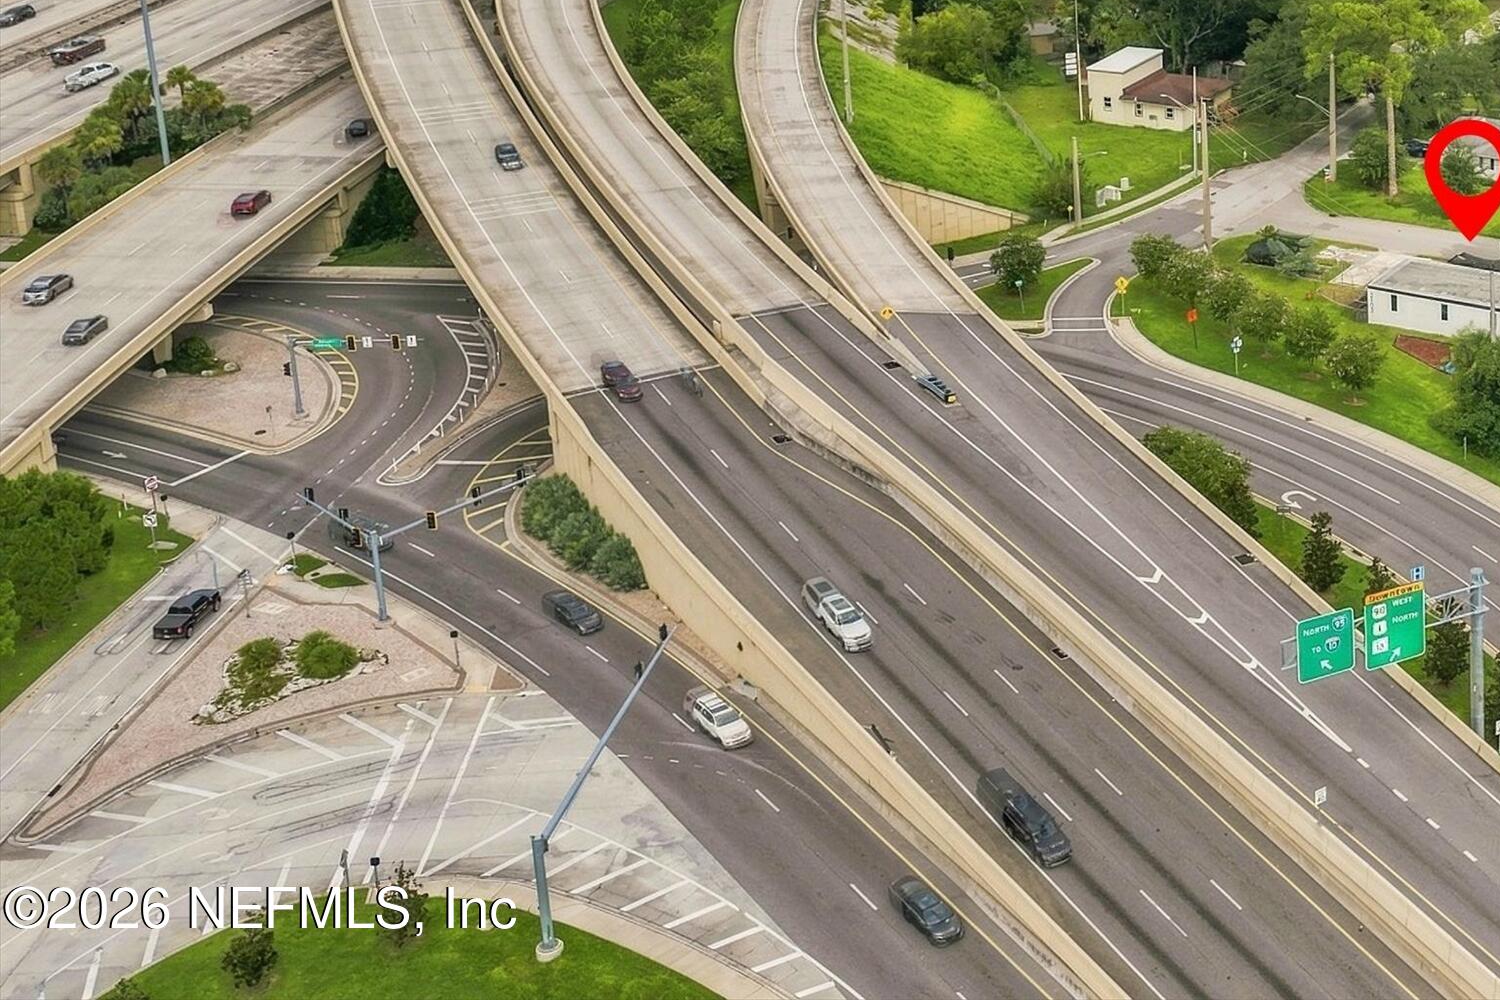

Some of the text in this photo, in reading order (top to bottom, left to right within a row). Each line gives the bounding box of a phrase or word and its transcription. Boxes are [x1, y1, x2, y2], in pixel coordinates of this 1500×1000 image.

[1368, 584, 1421, 603] Downtown
[1391, 596, 1413, 607] WEST
[1391, 611, 1418, 624] NORTH
[1303, 619, 1345, 637] NORTH 95
[1311, 641, 1338, 654] TO 10
